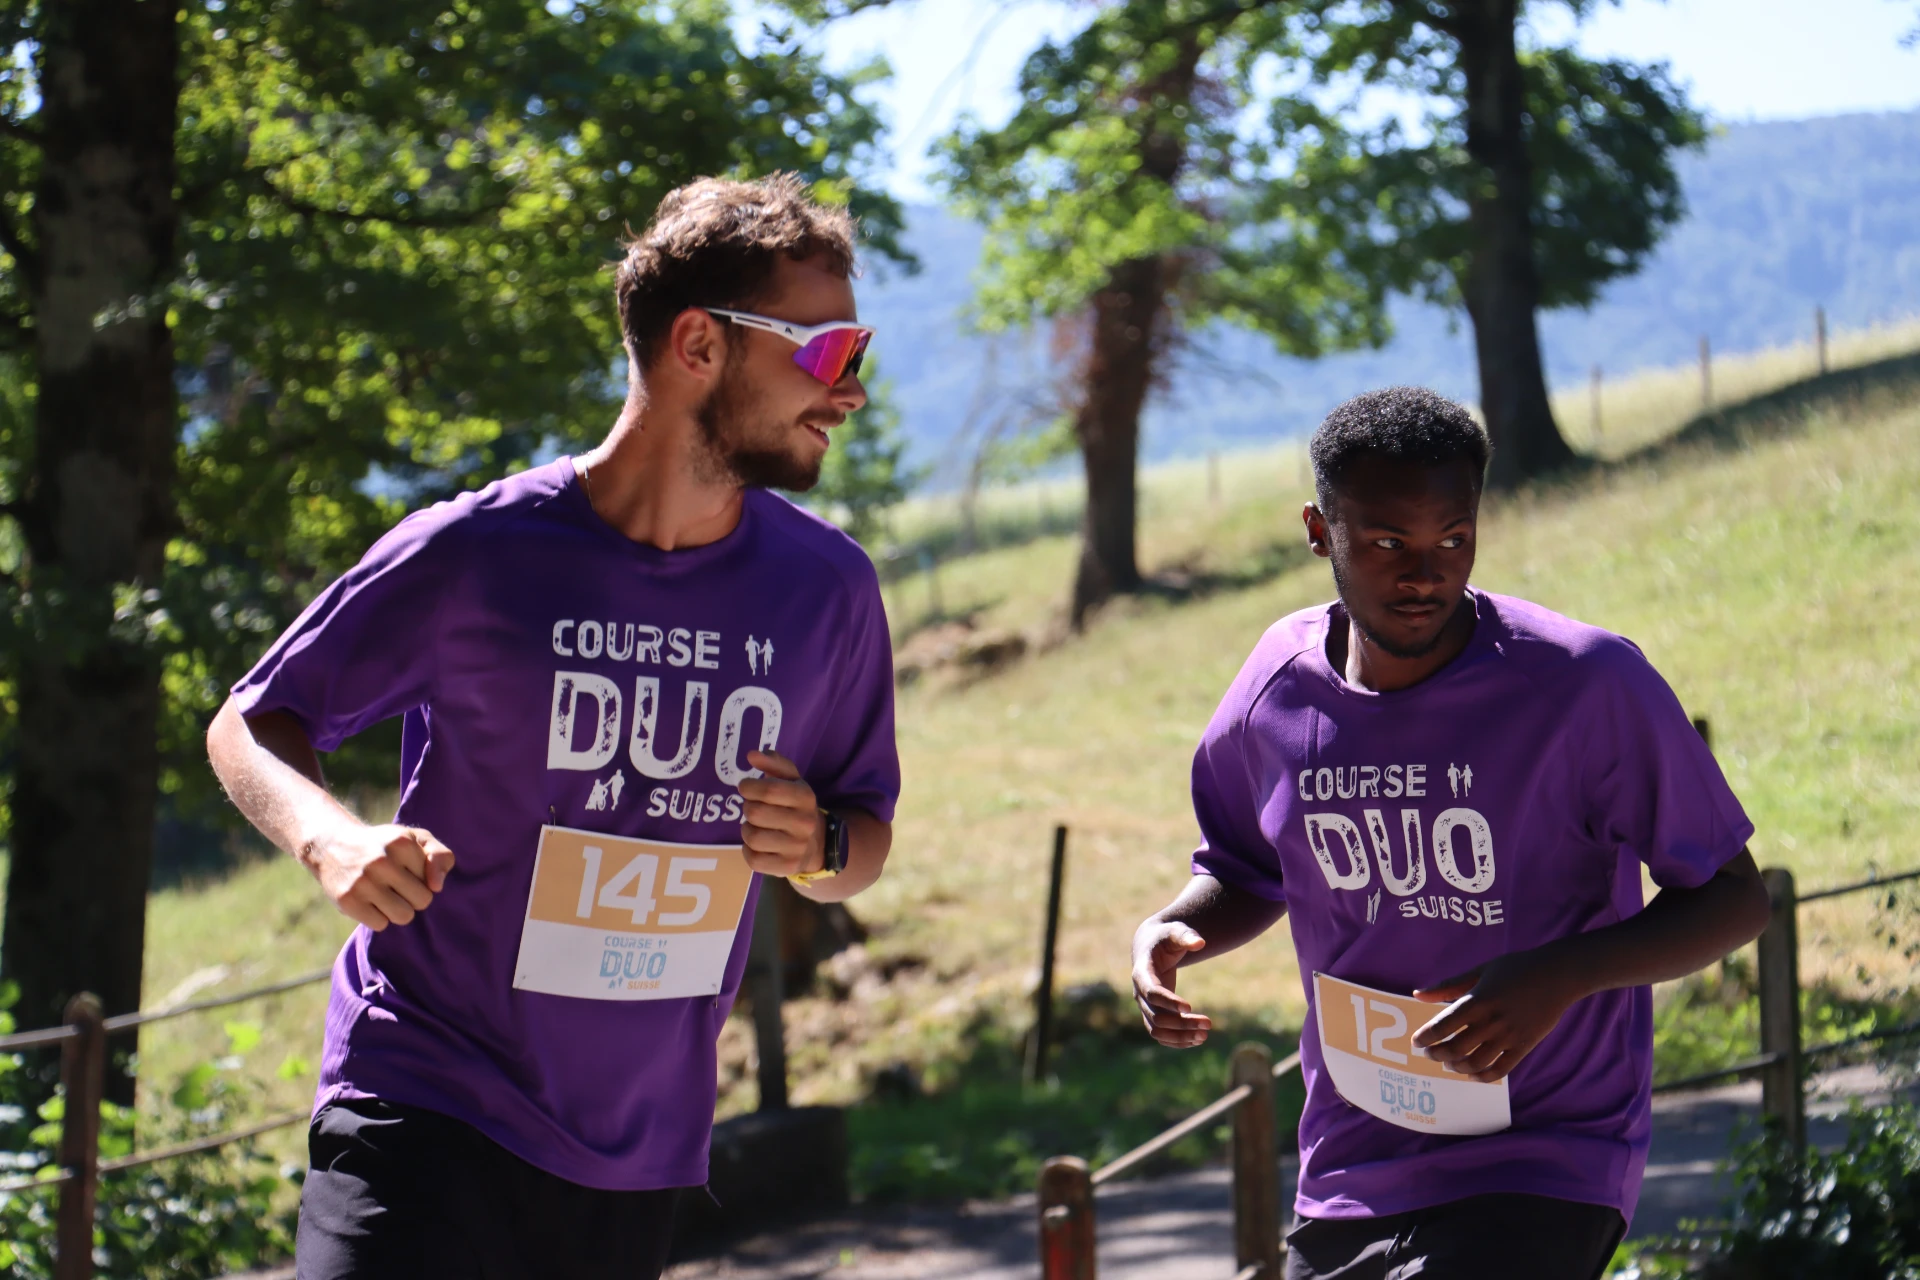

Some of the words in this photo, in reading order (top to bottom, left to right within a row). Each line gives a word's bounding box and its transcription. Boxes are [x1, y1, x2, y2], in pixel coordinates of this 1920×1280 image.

[553, 619, 720, 669] COURSE
[547, 670, 782, 787] DUO
[1299, 764, 1426, 801] COURSE
[646, 787, 748, 825] SUISS
[1304, 807, 1496, 896] DUO
[576, 845, 718, 926] 145
[1399, 895, 1504, 926] SUISSE
[604, 935, 653, 949] COURSE
[599, 950, 667, 979] DUO
[627, 980, 661, 990] SUISSE
[1378, 1068, 1417, 1087] COURSE
[1380, 1080, 1436, 1115] DUO
[1405, 1111, 1437, 1125] SUISSE
